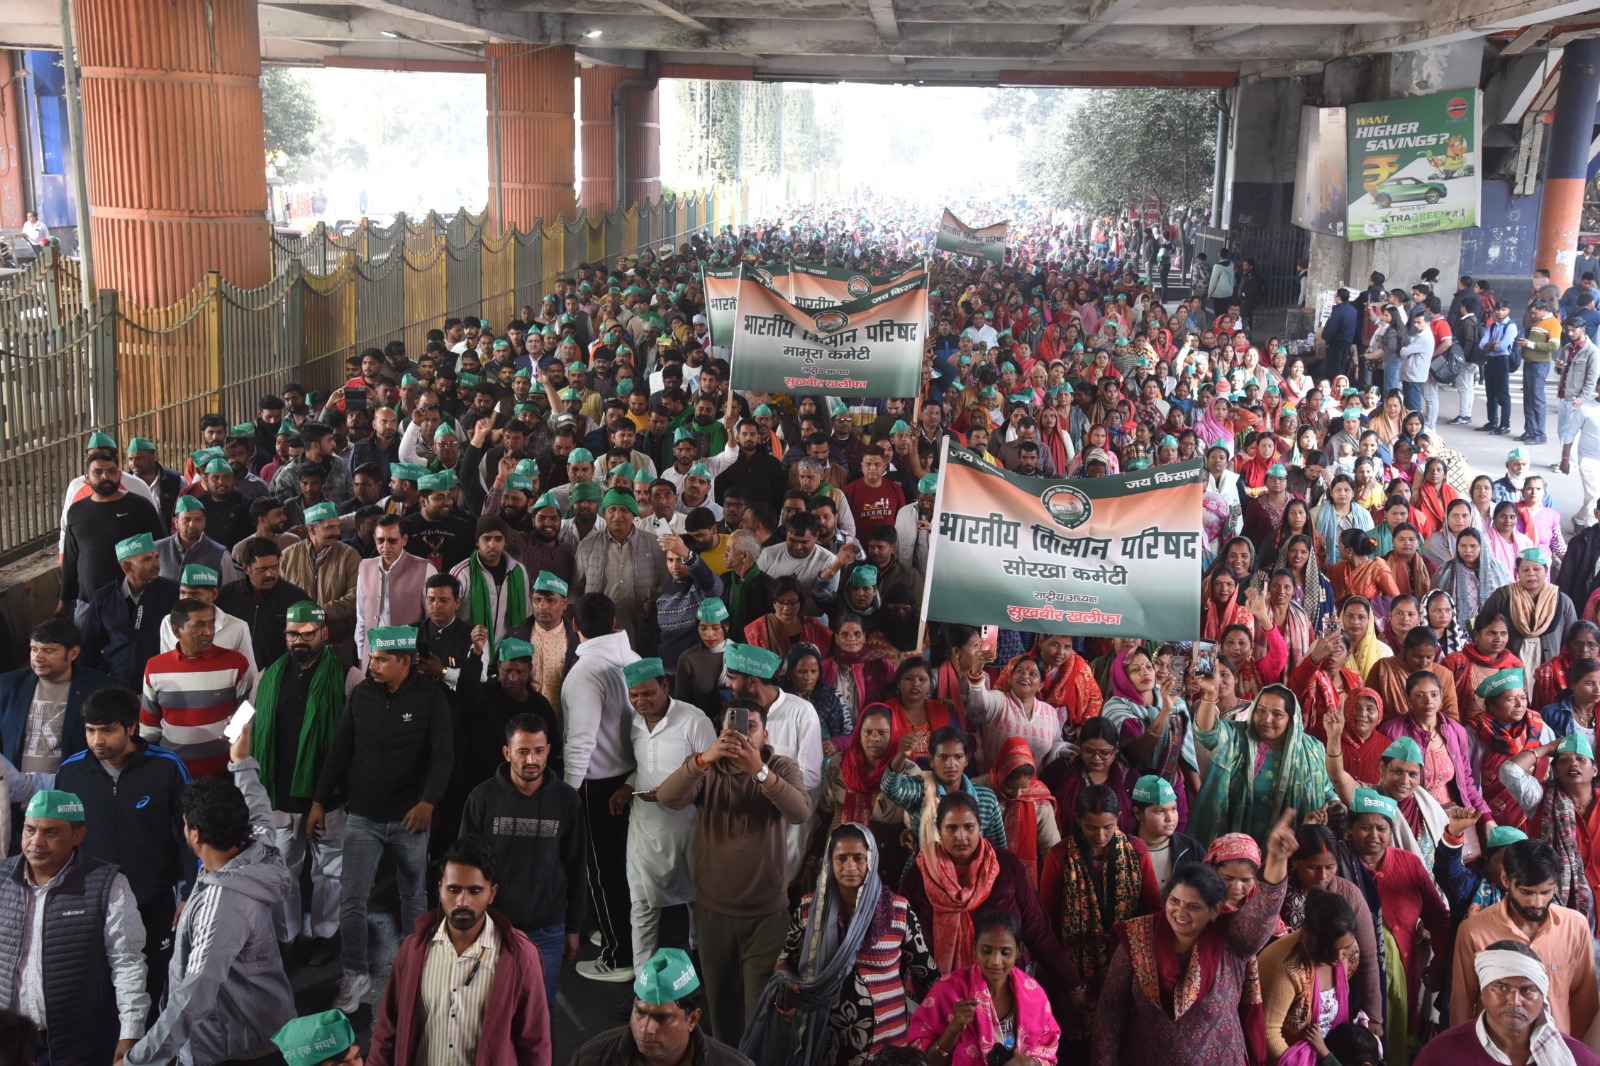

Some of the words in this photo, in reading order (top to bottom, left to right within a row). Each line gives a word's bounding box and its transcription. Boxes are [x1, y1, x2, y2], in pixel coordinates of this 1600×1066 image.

[1356, 115, 1390, 126] WANT
[1356, 122, 1419, 138] HIGHER
[1365, 133, 1450, 152] SAVINGS?
[890, 281, 921, 296] किसान
[744, 315, 796, 338] भारतीय
[864, 319, 918, 342] परिषद
[783, 346, 824, 363] मामूरा
[827, 346, 871, 361] कमेटी
[784, 376, 825, 388] सुखबीर
[826, 377, 868, 389] खलीफा
[949, 450, 973, 462] जय
[1125, 478, 1151, 489] जय
[1154, 468, 1201, 484] किसान
[939, 512, 1021, 549] भारतीय
[1031, 524, 1112, 560] किसान
[1121, 526, 1200, 560] परिषद
[1003, 555, 1066, 579] सोरखा
[1071, 564, 1128, 585] कमेटी
[1033, 590, 1064, 603] राष्ट्रीय
[1066, 593, 1098, 603] अध्यक्ष
[1007, 604, 1064, 622] सुखबीर
[1066, 608, 1122, 625] खलीफा
[376, 638, 396, 648] किसान
[397, 638, 407, 647] एक
[57, 801, 77, 813] भारतीय
[1364, 797, 1385, 808] किसान
[673, 970, 692, 991] भारतीय
[284, 1050, 297, 1060] सान
[298, 1045, 312, 1058] एक
[314, 1034, 337, 1051] संघर्ष
